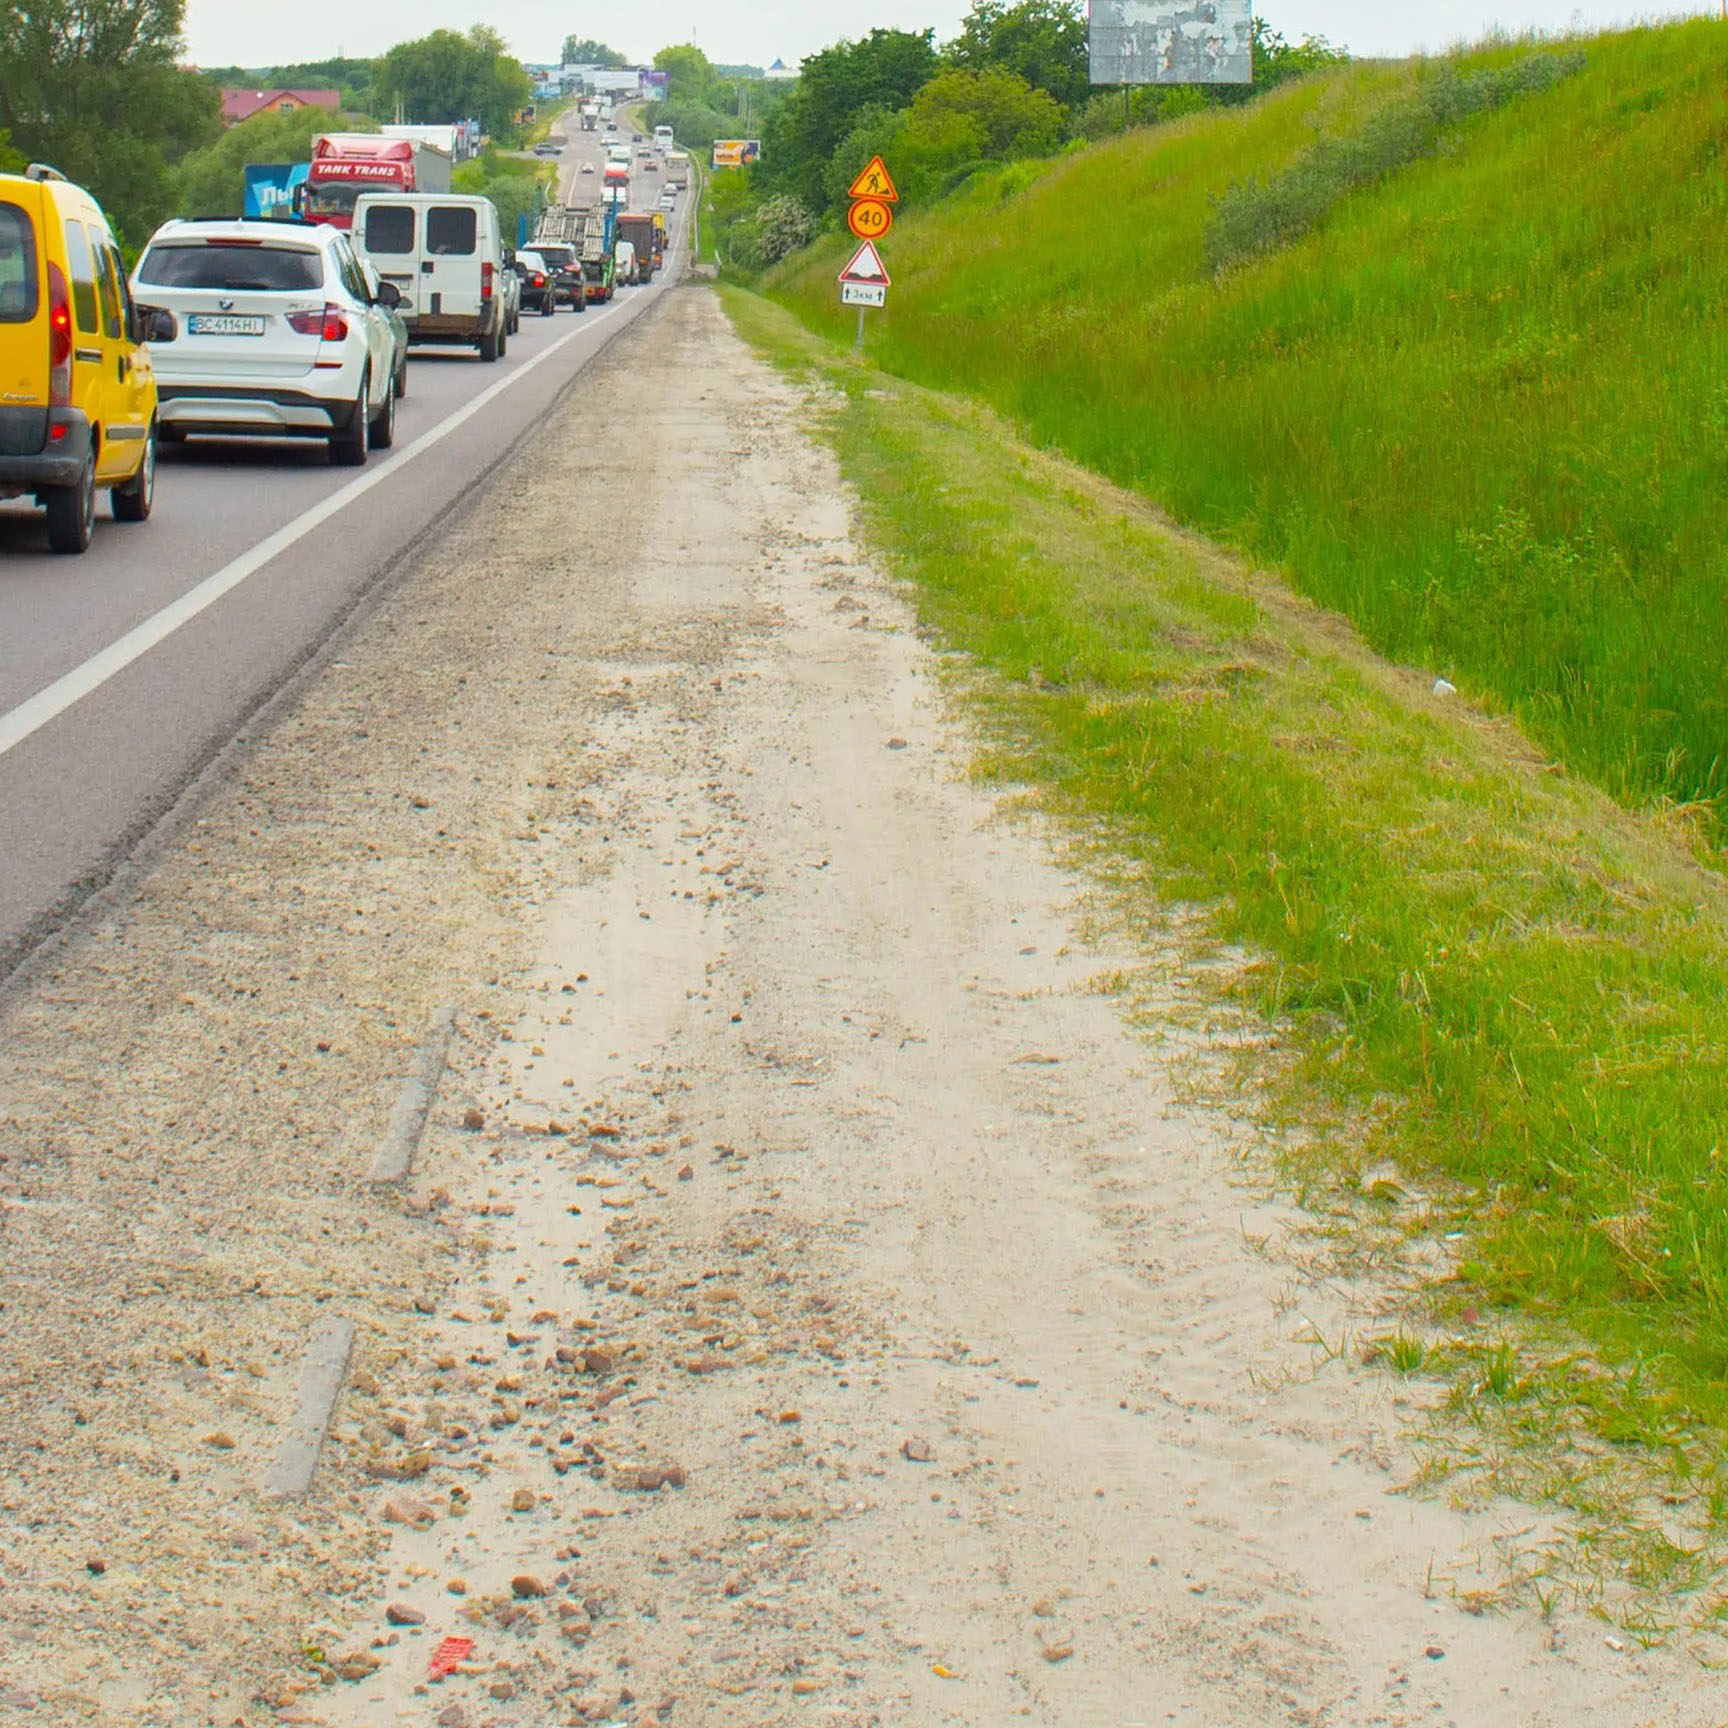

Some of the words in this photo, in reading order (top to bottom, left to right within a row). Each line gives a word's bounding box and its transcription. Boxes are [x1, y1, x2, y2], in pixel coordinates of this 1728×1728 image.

[318, 165, 352, 175] TANK
[354, 166, 396, 177] TRANS
[858, 210, 883, 226] 40
[197, 318, 212, 330] BC
[215, 318, 242, 330] 4114
